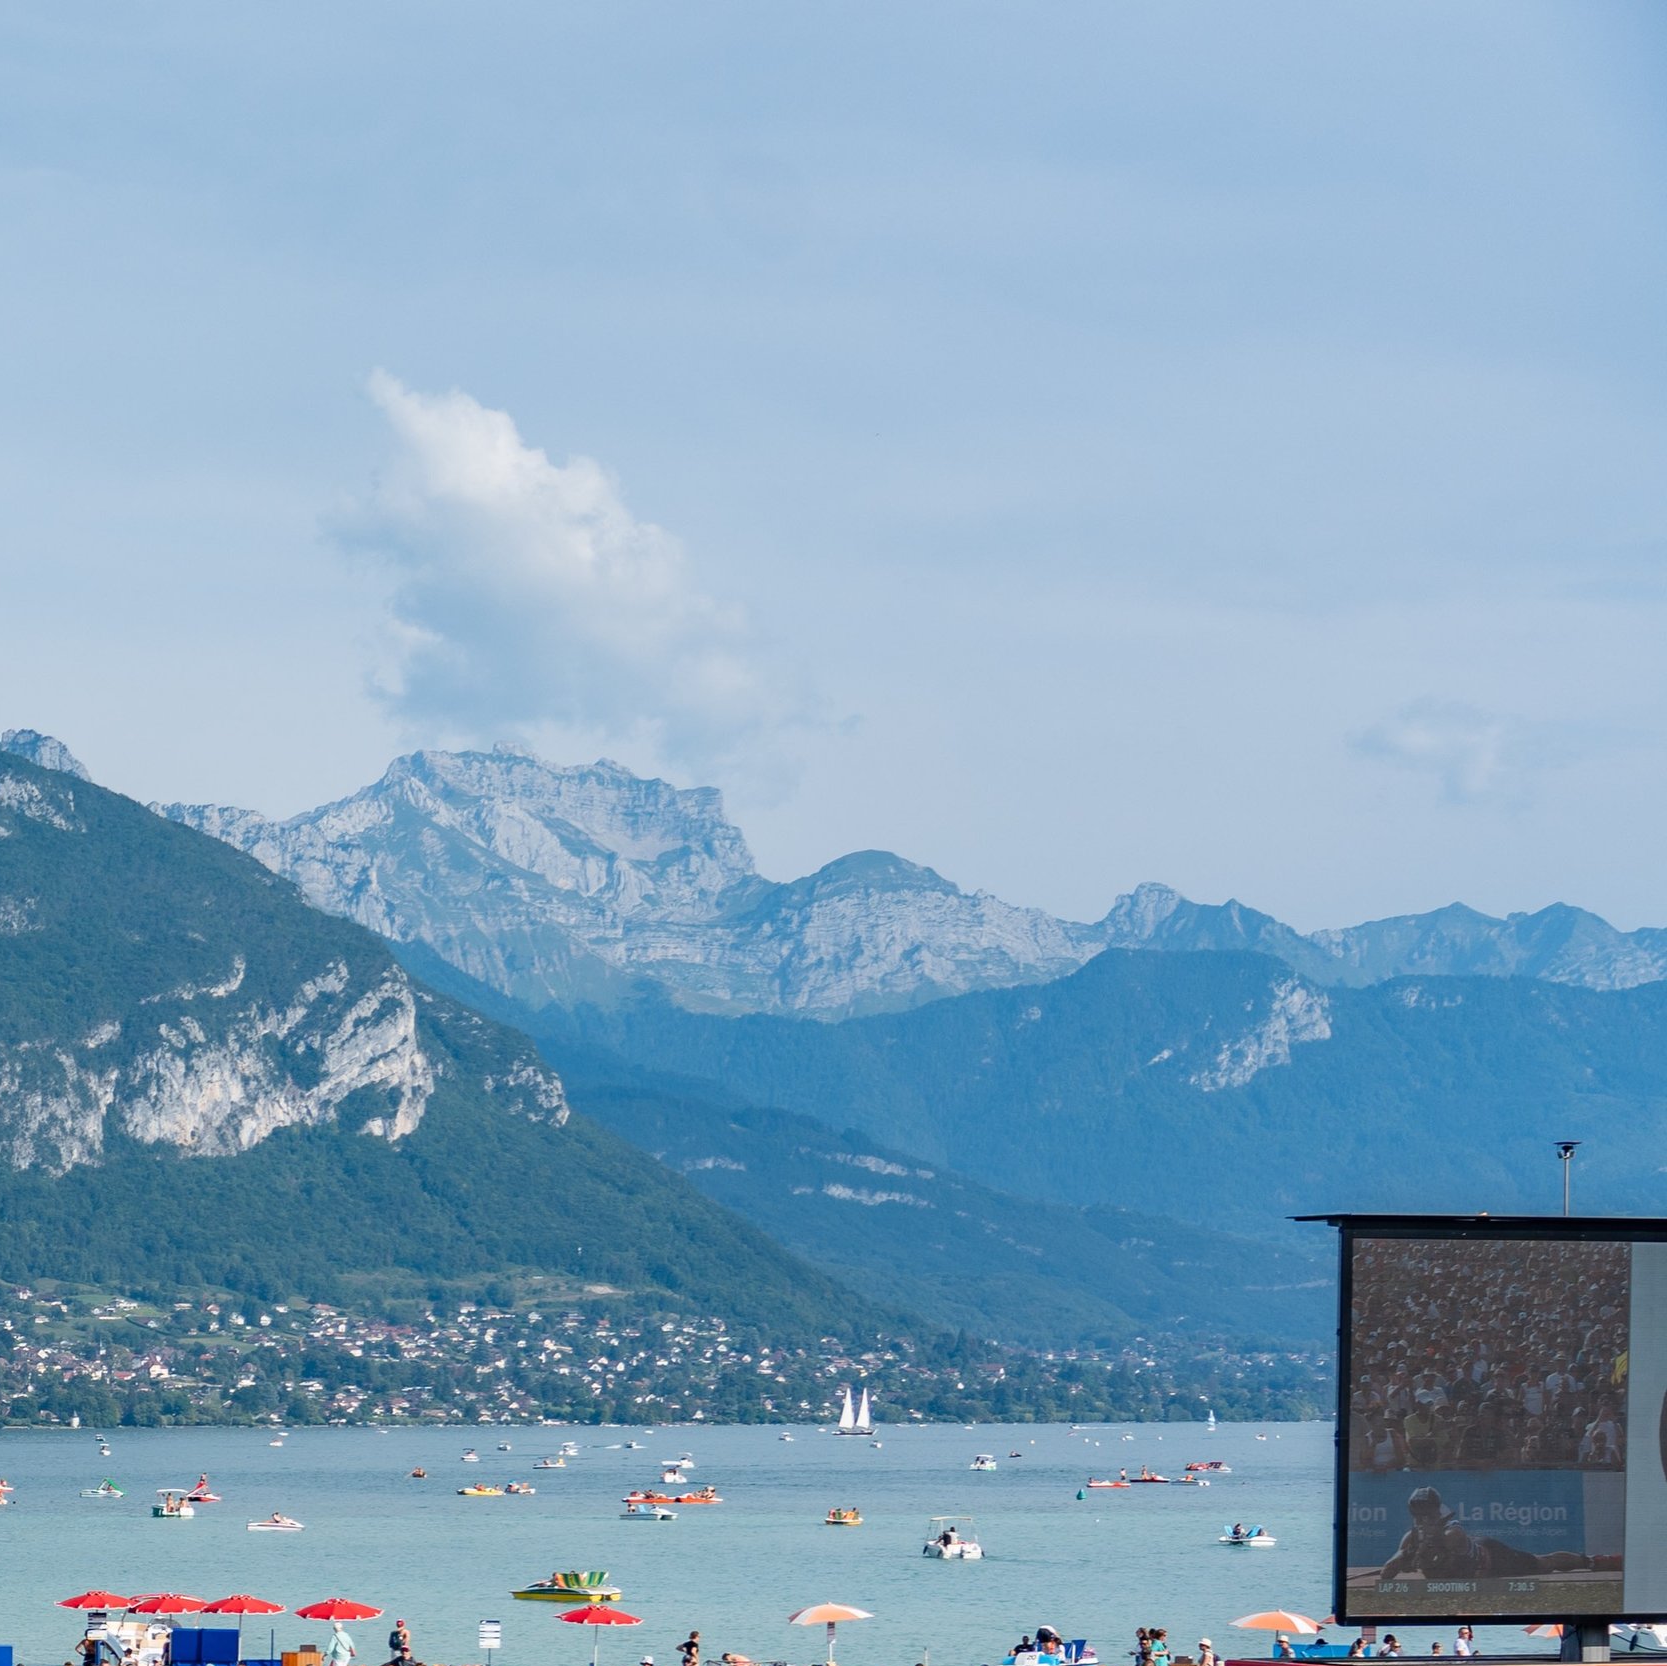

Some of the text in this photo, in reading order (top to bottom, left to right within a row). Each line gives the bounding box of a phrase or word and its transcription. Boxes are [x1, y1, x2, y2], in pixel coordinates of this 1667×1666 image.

[1459, 1501, 1567, 1526] La Région
[1378, 1582, 1409, 1593] LAP 2/6
[1427, 1582, 1477, 1593] SHOOTING 1
